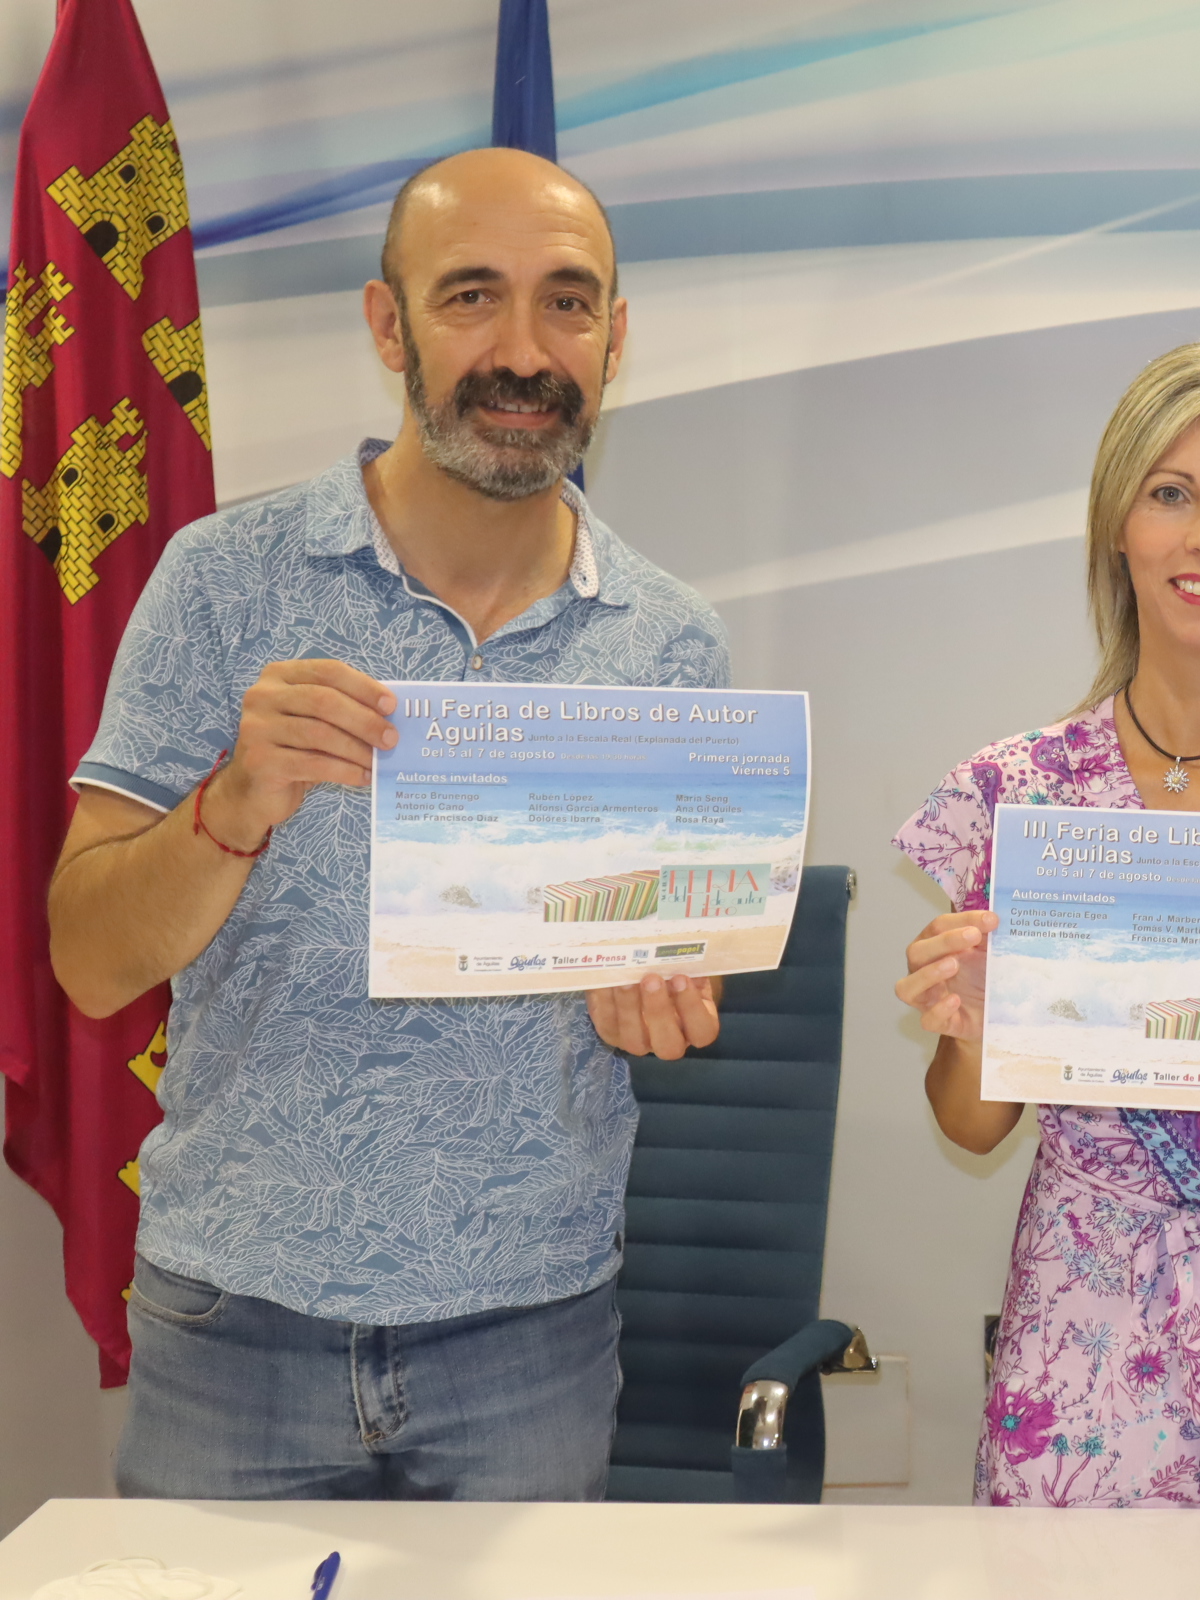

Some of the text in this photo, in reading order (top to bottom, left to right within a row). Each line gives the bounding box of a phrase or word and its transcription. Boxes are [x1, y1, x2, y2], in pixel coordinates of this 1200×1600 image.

[405, 698, 758, 723] III Feria de Libros de Autor
[426, 717, 524, 745] Águilas
[528, 734, 554, 742] Junto
[611, 735, 631, 743] Real
[634, 736, 686, 745] (Explanada
[706, 737, 739, 745] Puerto)
[421, 747, 555, 761] Del 5 al 7 de agosto
[689, 752, 790, 765] Primera jornada
[732, 766, 790, 776] Viernes 5
[396, 772, 508, 784] Autores invitados
[431, 792, 479, 801] Brunengo
[529, 793, 593, 803] Rubén López
[705, 795, 728, 804] Seng
[395, 803, 464, 811] Antonio Cano
[676, 805, 742, 813] Ana Gil Quiles
[424, 814, 473, 822] Francisco
[571, 815, 601, 823] Ibarra
[702, 816, 724, 825] Raya
[1024, 820, 1047, 838] III
[1057, 821, 1120, 842] Feria
[1129, 826, 1159, 844] de
[1042, 838, 1133, 866] Águilas
[1136, 857, 1161, 865] Junto
[1037, 866, 1161, 882] Del 5 al 7 de agosto
[1012, 889, 1116, 903] Autores invitados
[1011, 908, 1108, 920] Cynthia Egea
[1133, 913, 1200, 924] Fran Marber
[1033, 919, 1078, 929] Gutiérrez
[1010, 929, 1056, 938] Marianela
[1132, 934, 1178, 943] Francisca
[552, 956, 578, 964] Taller
[596, 954, 626, 962] Prensa
[1153, 1072, 1180, 1081] Taller
